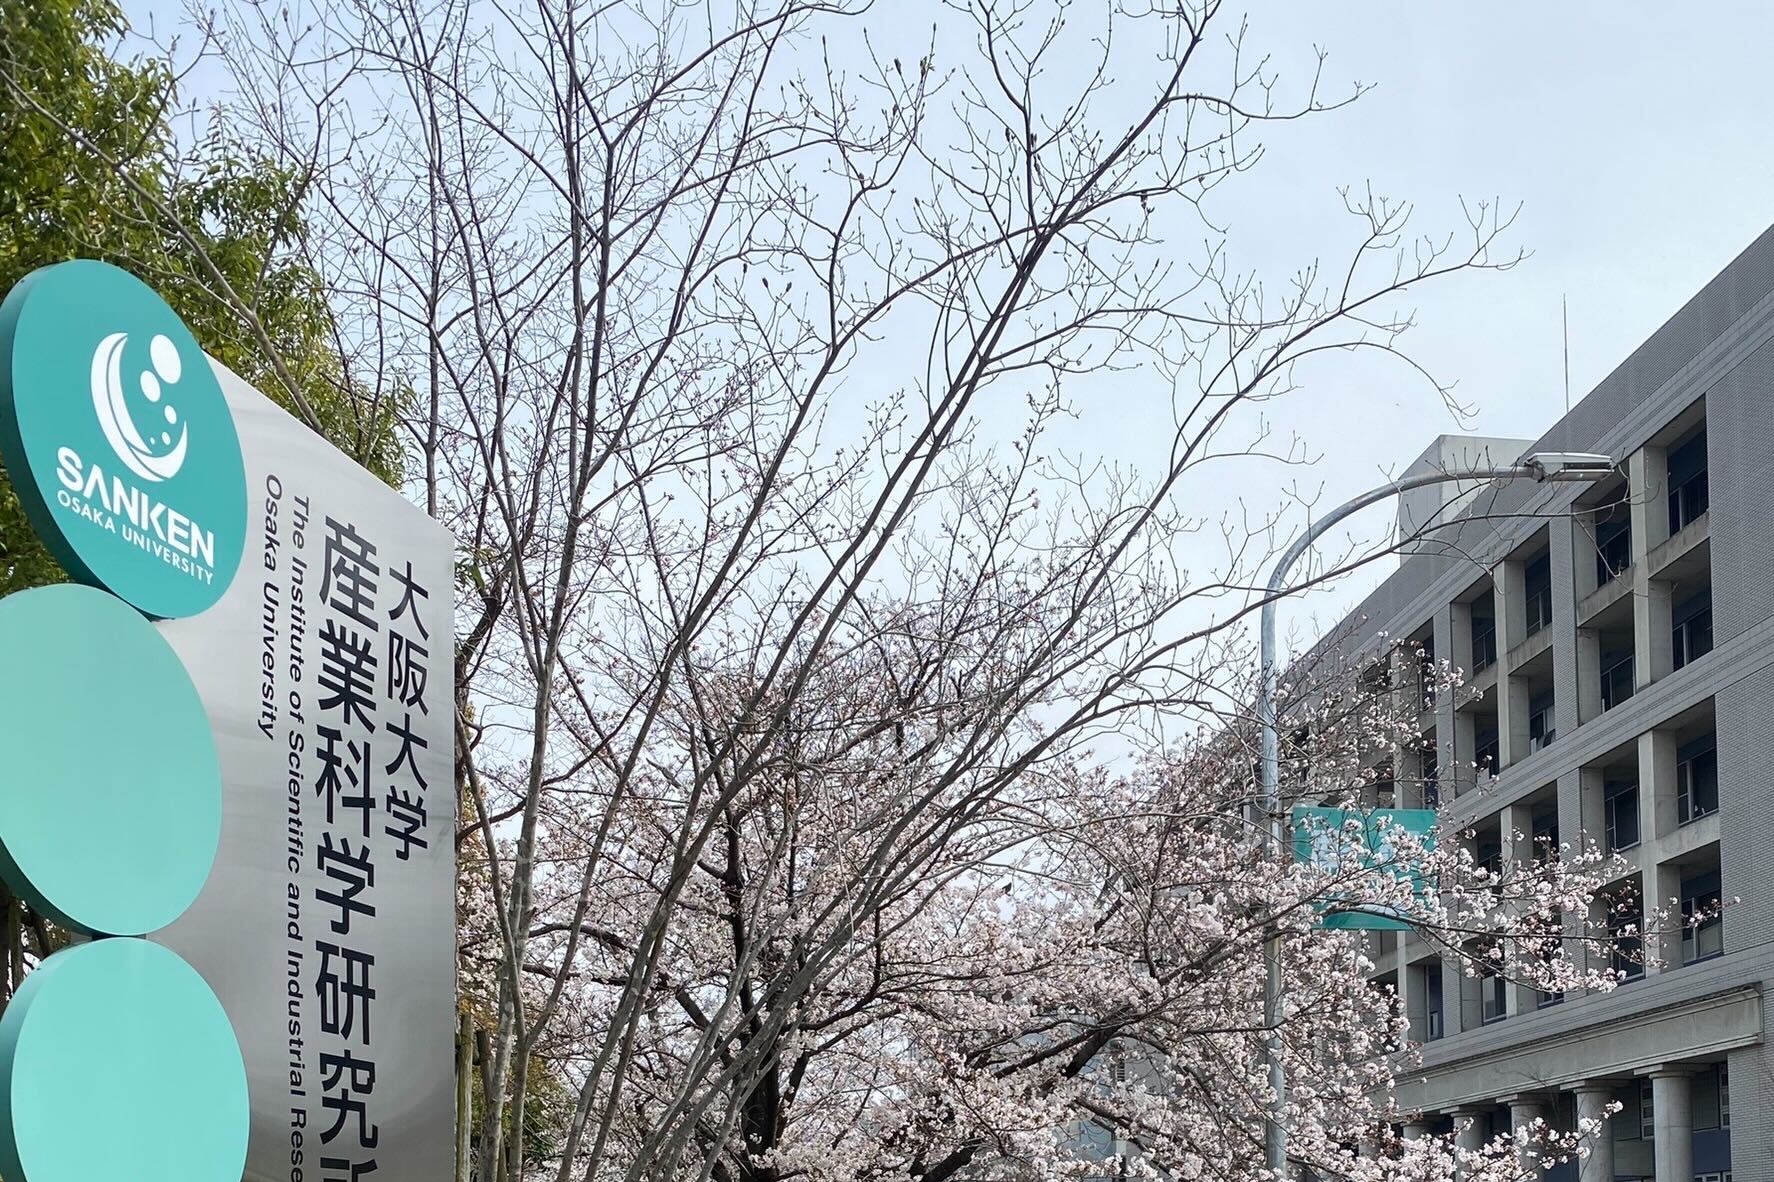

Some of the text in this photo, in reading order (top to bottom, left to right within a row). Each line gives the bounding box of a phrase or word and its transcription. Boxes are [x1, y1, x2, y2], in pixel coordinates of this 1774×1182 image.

[56, 446, 214, 568] SANKEN
[57, 489, 214, 585] OSAKA UNIVERSITY
[292, 495, 310, 550] The
[258, 474, 283, 740] Osaka University
[289, 556, 308, 683] Institute
[289, 690, 304, 724] of
[385, 560, 430, 861] 大阪大学
[287, 730, 305, 874] Scientific
[287, 882, 303, 941] and
[287, 950, 306, 1096] Industrial
